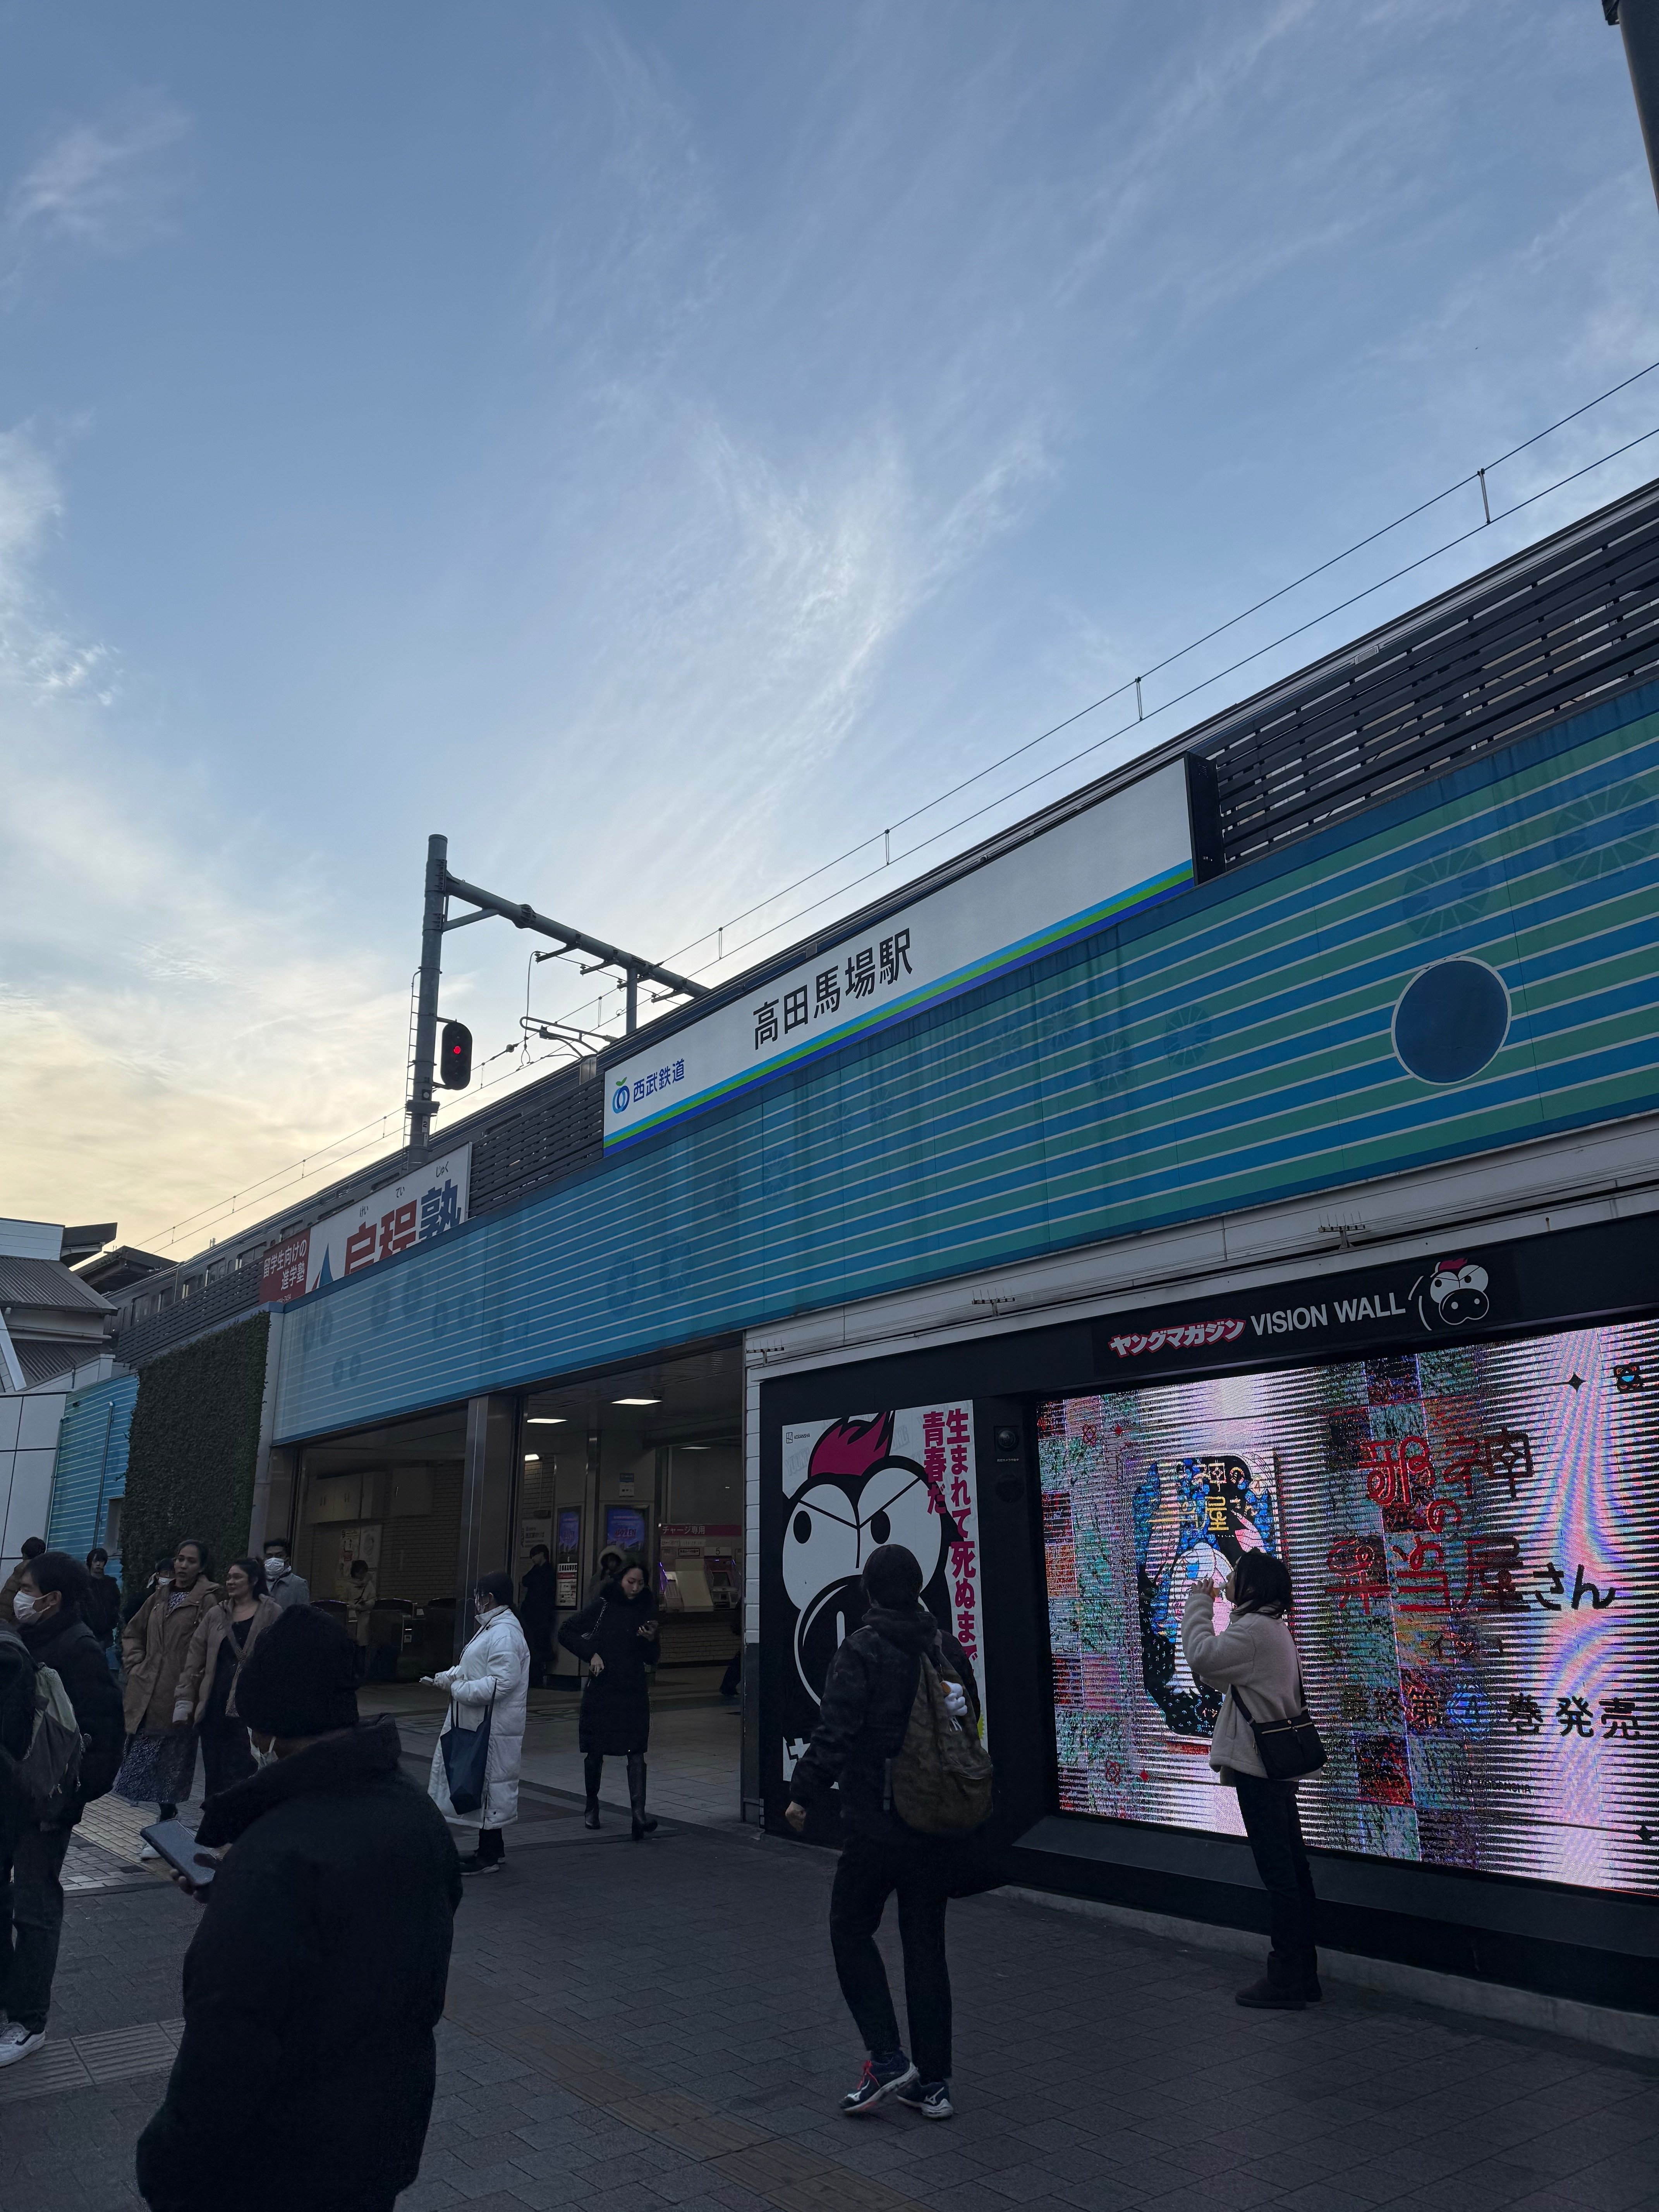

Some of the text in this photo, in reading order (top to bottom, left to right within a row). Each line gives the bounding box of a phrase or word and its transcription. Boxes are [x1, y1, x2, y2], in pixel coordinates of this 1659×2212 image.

[753, 927, 913, 1050] 高田馬場駅
[633, 1058, 685, 1103] 西武鉄道
[263, 1239, 307, 1279] 留学生向けの
[281, 1261, 305, 1290] 進学塾
[1110, 1292, 1406, 1356] ヤングマガジン VISION WALL
[923, 1411, 946, 1515] 青春だ
[662, 1525, 705, 1535] チャージ専用
[716, 1547, 720, 1555] 5
